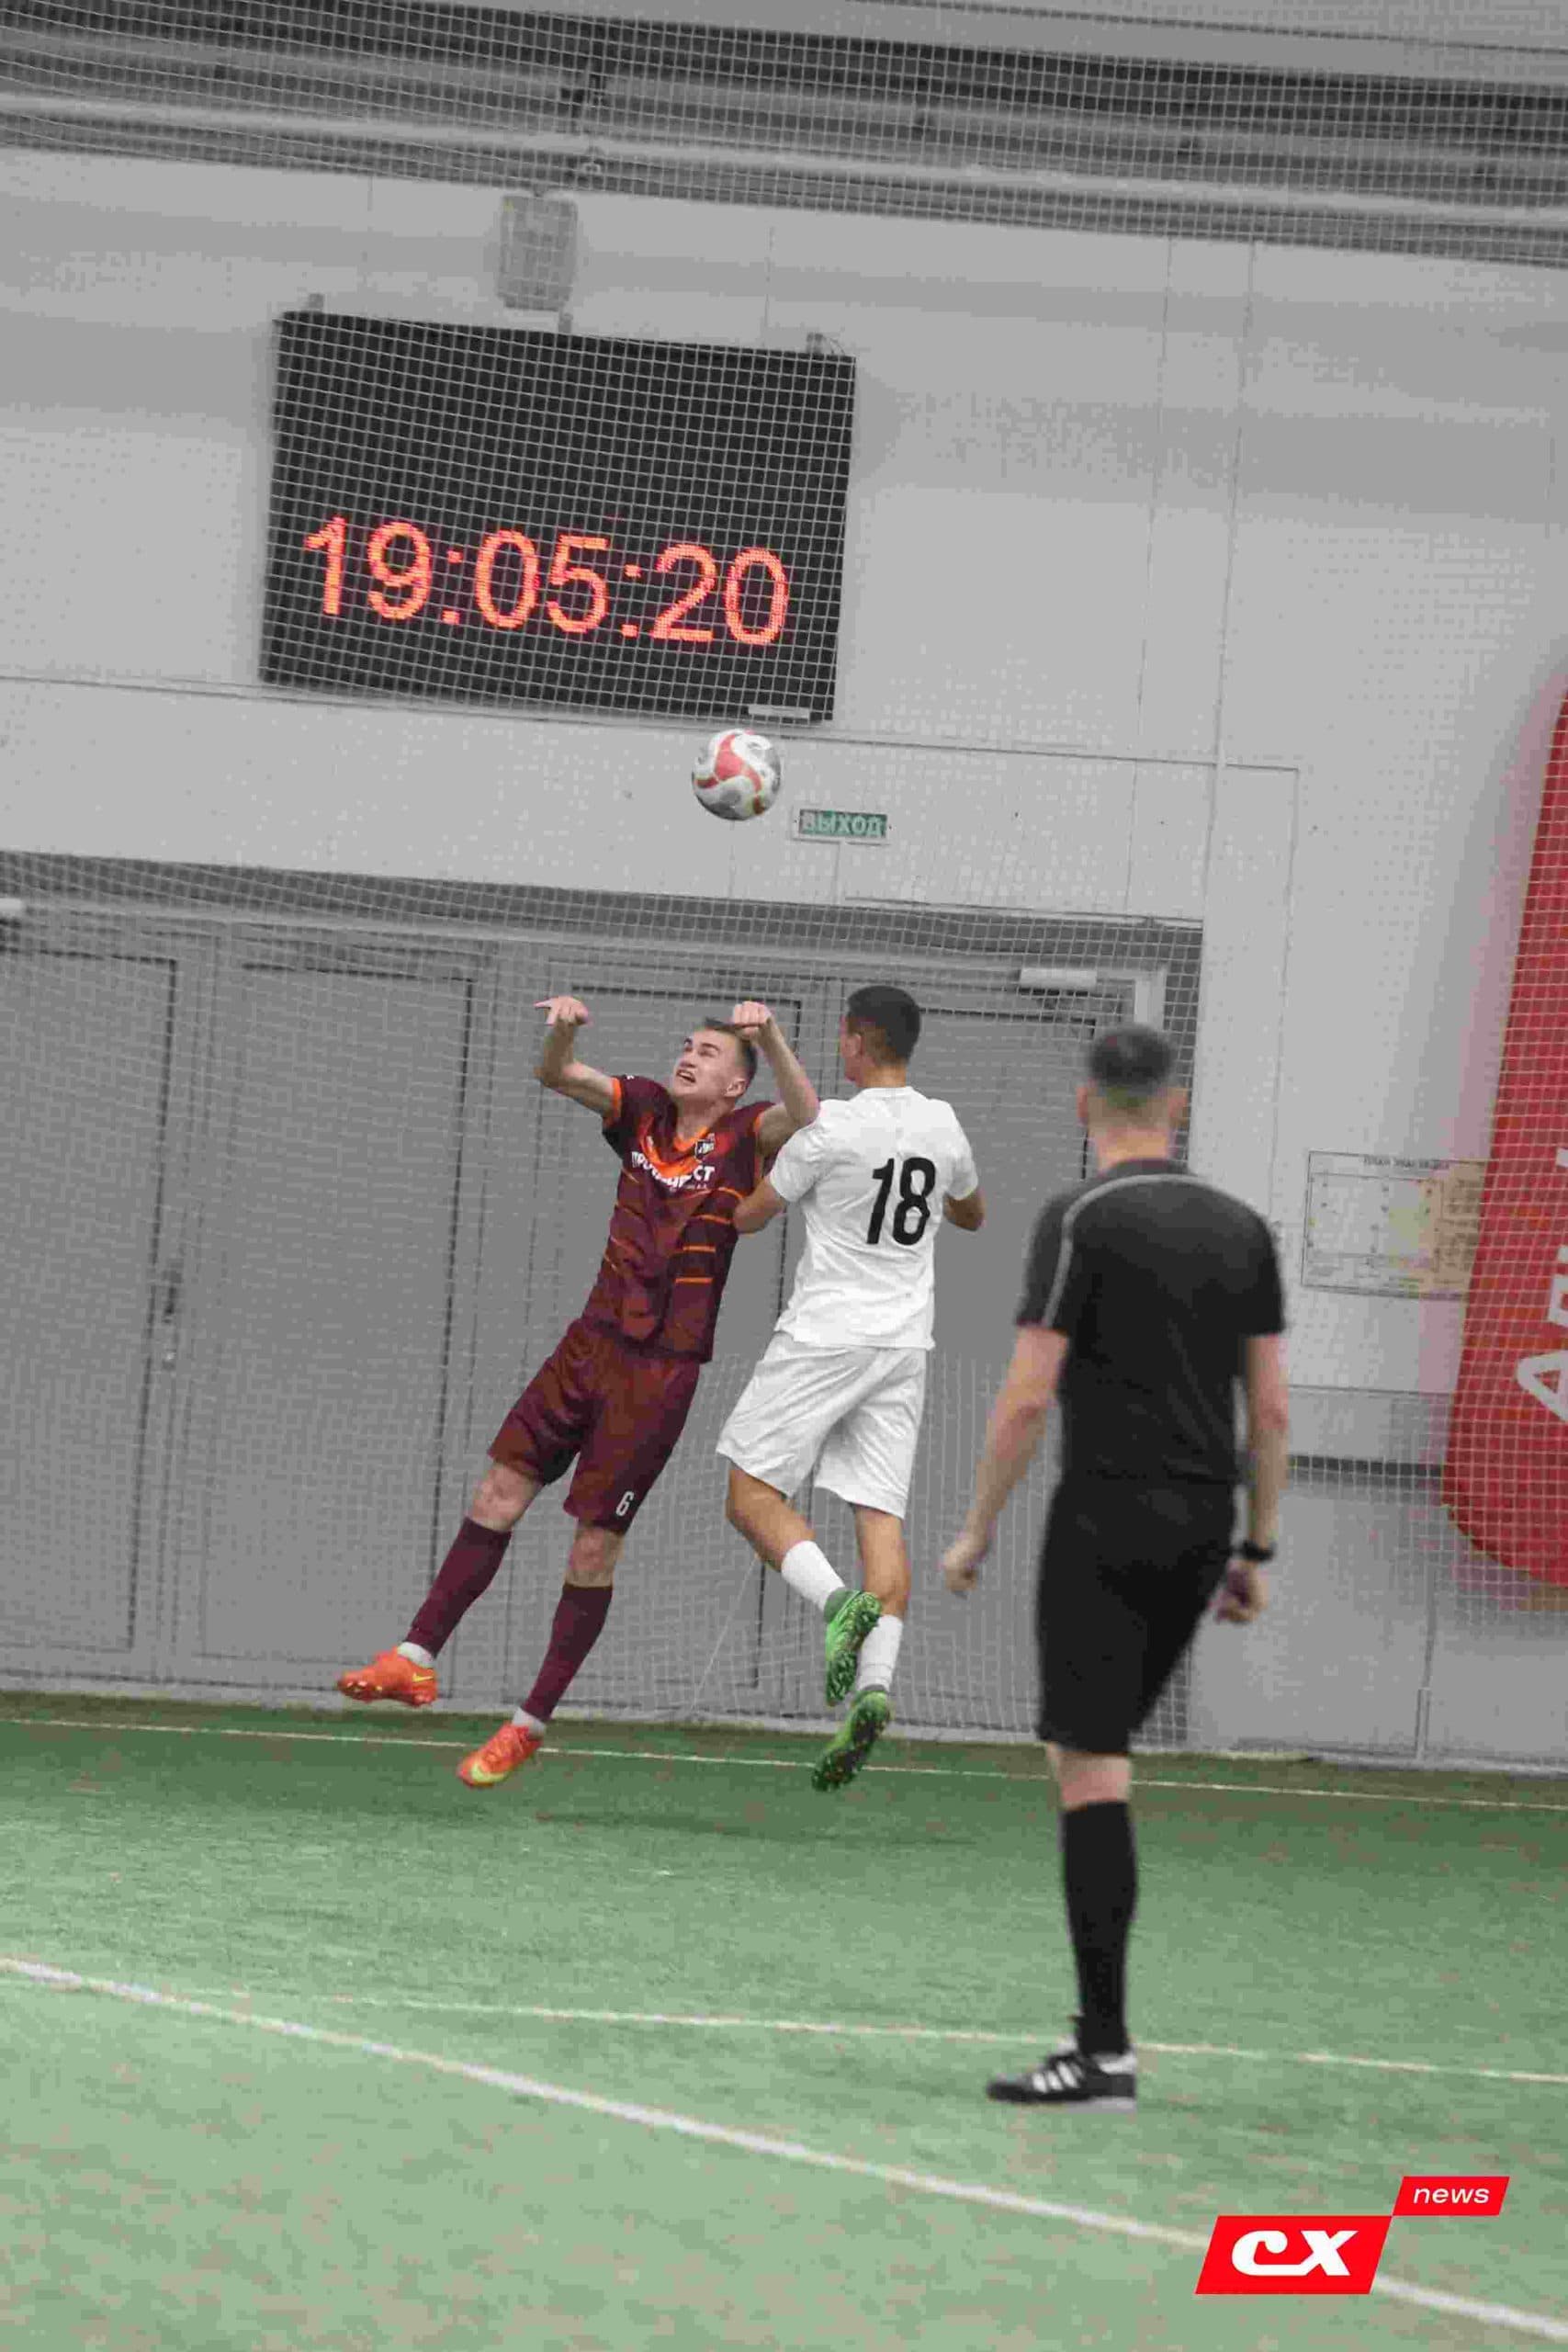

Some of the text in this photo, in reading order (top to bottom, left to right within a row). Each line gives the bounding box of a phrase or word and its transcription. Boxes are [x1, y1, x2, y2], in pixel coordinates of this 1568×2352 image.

[304, 514, 790, 646] 19:05:20
[866, 1157, 935, 1246] 18
[615, 1491, 635, 1516] 6
